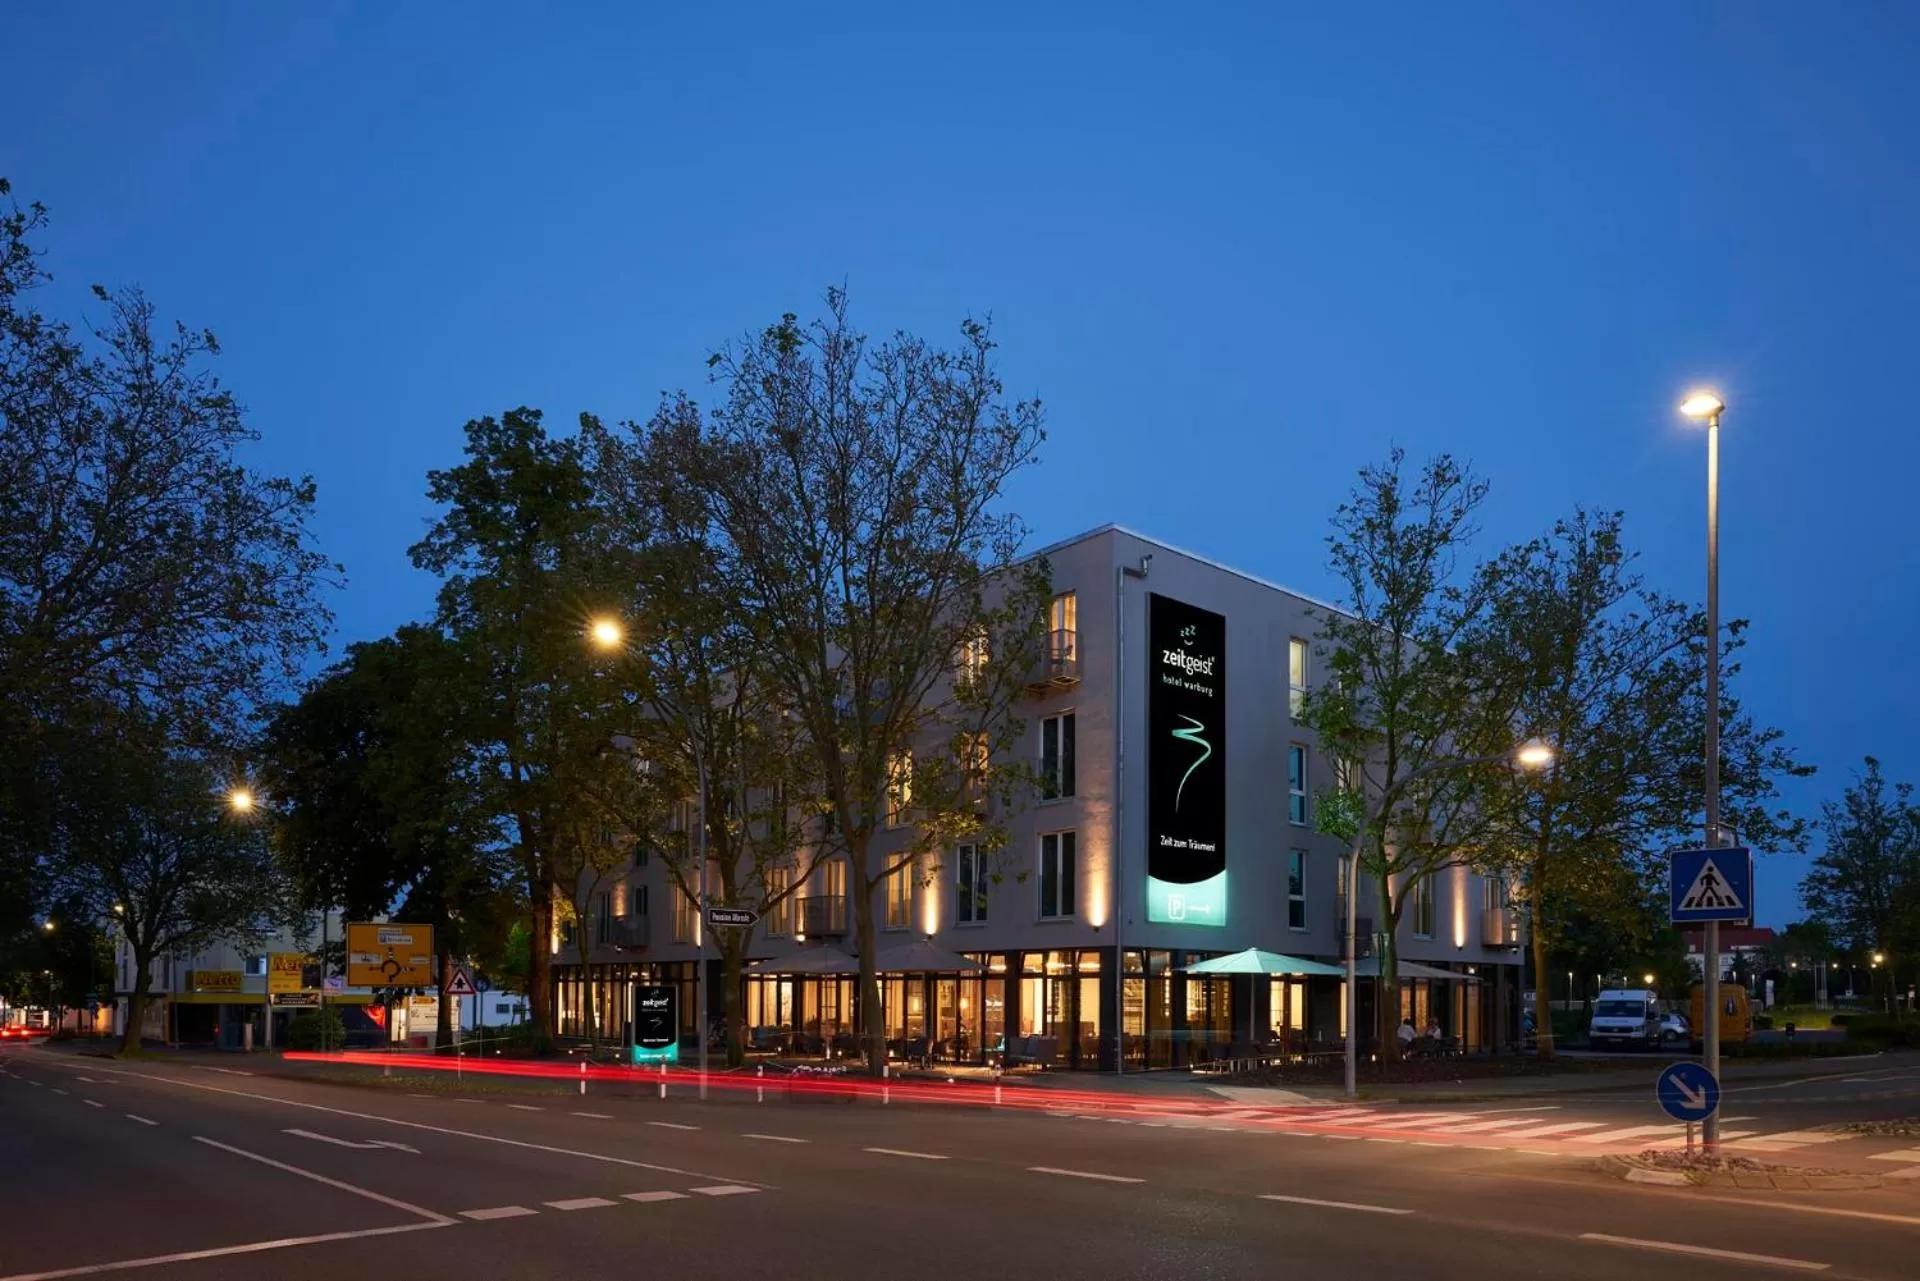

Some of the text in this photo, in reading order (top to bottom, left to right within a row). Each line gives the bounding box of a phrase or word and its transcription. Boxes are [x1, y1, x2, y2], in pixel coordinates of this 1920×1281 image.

[1162, 672, 1213, 697] hotel warburg
[1160, 835, 1172, 846] Zeit
[1173, 839, 1187, 848] zum
[197, 972, 241, 986] Netto
